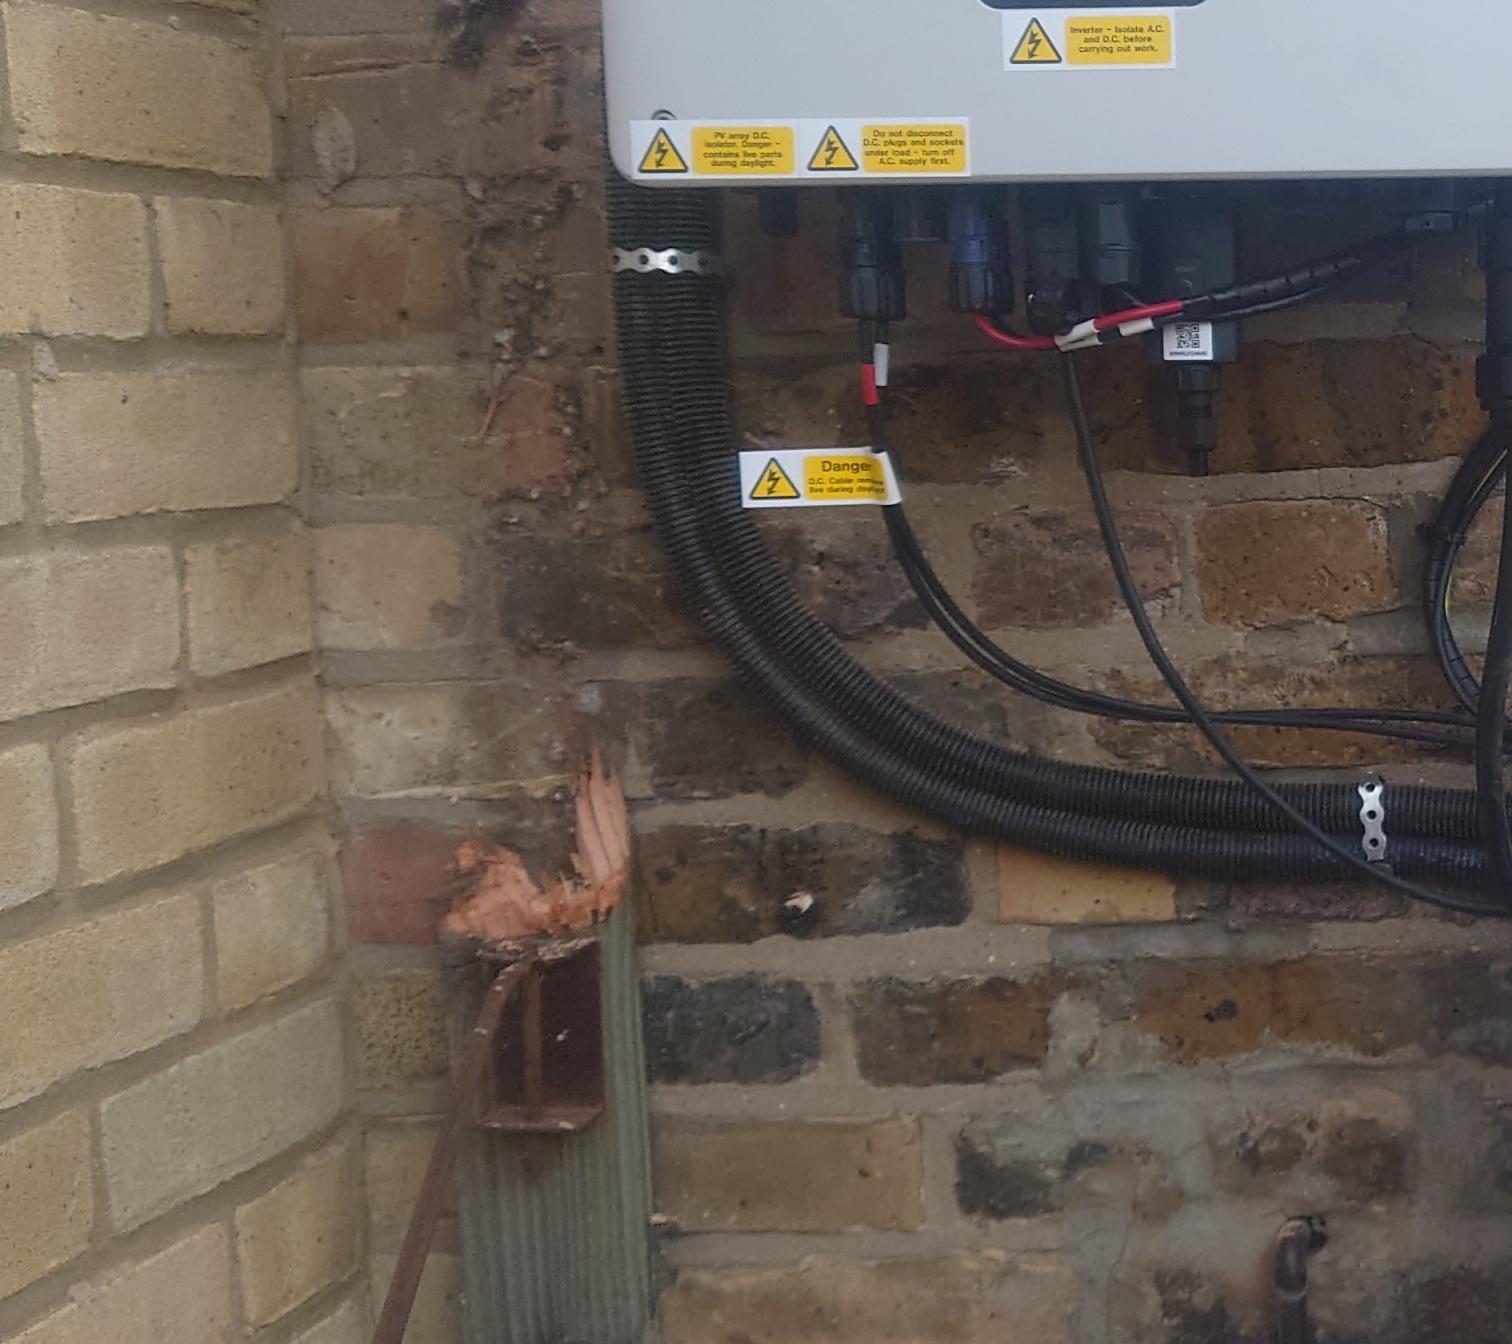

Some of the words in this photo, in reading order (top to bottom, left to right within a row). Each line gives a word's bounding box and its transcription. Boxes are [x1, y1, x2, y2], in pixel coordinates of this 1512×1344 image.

[1070, 25, 1102, 34] Inverter
[1147, 24, 1164, 33] A.C.
[1083, 35, 1099, 43] and
[1103, 35, 1120, 43] D.C.
[1123, 34, 1152, 43] before
[1079, 45, 1114, 54] carrying
[1117, 44, 1131, 53] out
[1135, 44, 1158, 52] work.
[873, 129, 885, 137] Do
[888, 129, 902, 137] not
[906, 129, 953, 137] disconnect
[883, 138, 907, 147] plugs
[910, 138, 926, 146] and
